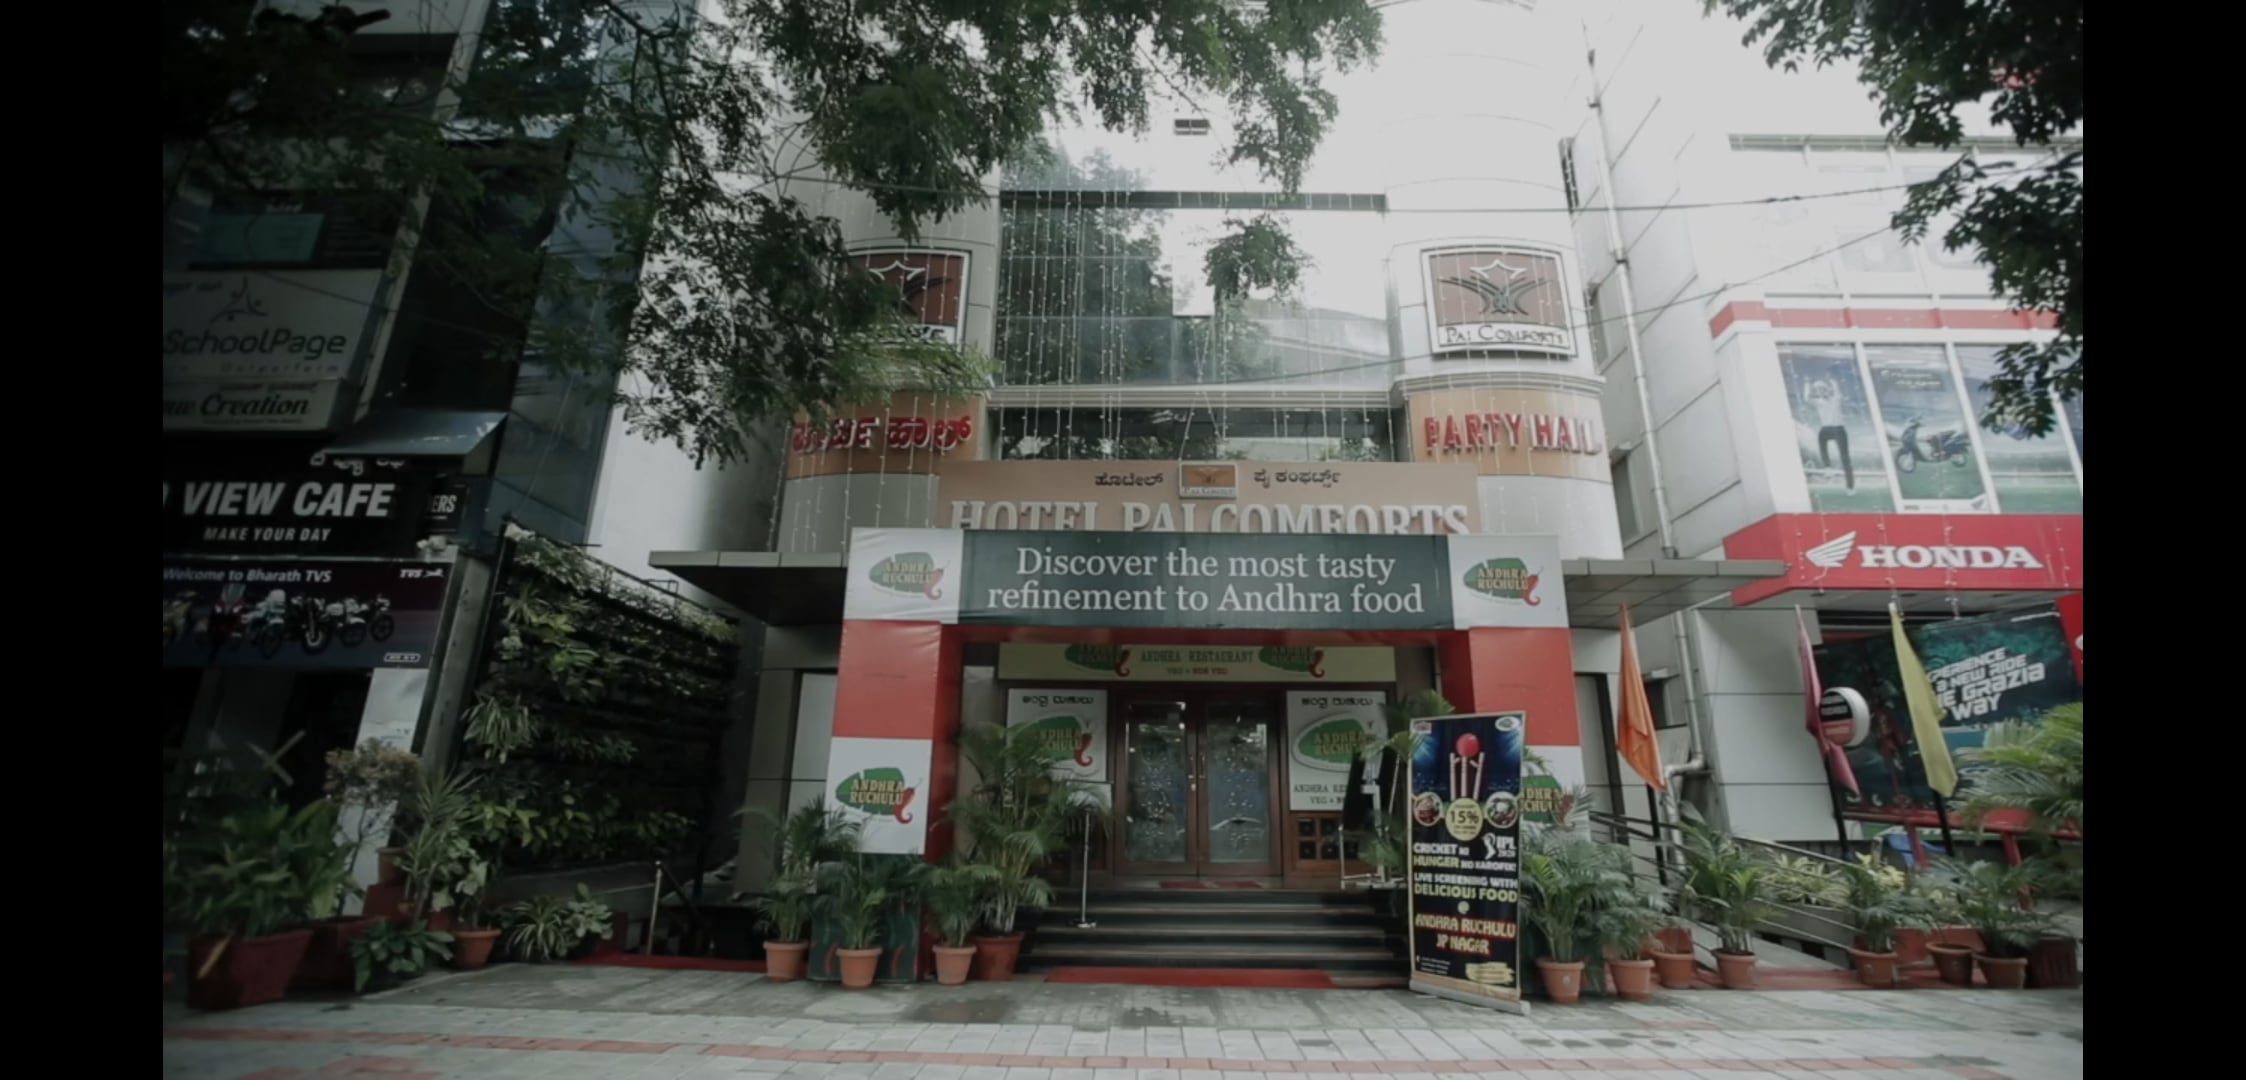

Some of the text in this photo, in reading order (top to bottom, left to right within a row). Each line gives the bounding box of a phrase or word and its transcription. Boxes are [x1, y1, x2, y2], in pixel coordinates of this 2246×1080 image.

[163, 328, 347, 361] SchoolPage
[201, 393, 309, 416] Creation
[1424, 412, 1522, 452] PARTY
[181, 481, 286, 518] VIEW
[292, 481, 396, 518] CAFE
[203, 527, 332, 542] MAKE YOUR DAY
[1016, 547, 1396, 583] Discover the most tasty
[1857, 545, 2045, 569] HONDA
[163, 568, 332, 583] Welcome to Bharath TVS
[1479, 568, 1527, 579] ANDHRA
[987, 581, 1425, 614] refinement to Andhra food
[1950, 667, 1987, 688] NEW
[1989, 653, 2028, 677] RIDE
[853, 779, 904, 791] ANDHRA
[850, 791, 904, 805] RUCHULU
[1450, 810, 1480, 824] 15%
[1413, 842, 1458, 855] CRICKET
[1496, 836, 1517, 850] IPL
[1414, 855, 1459, 869] HUNGER
[1414, 872, 1518, 888] LIVE SCREENING WITH
[1414, 883, 1518, 902] DELICIOUS FOOD
[1415, 913, 1517, 939] ANDHRA RUCHULU
[1450, 935, 1490, 955] NAGAR
